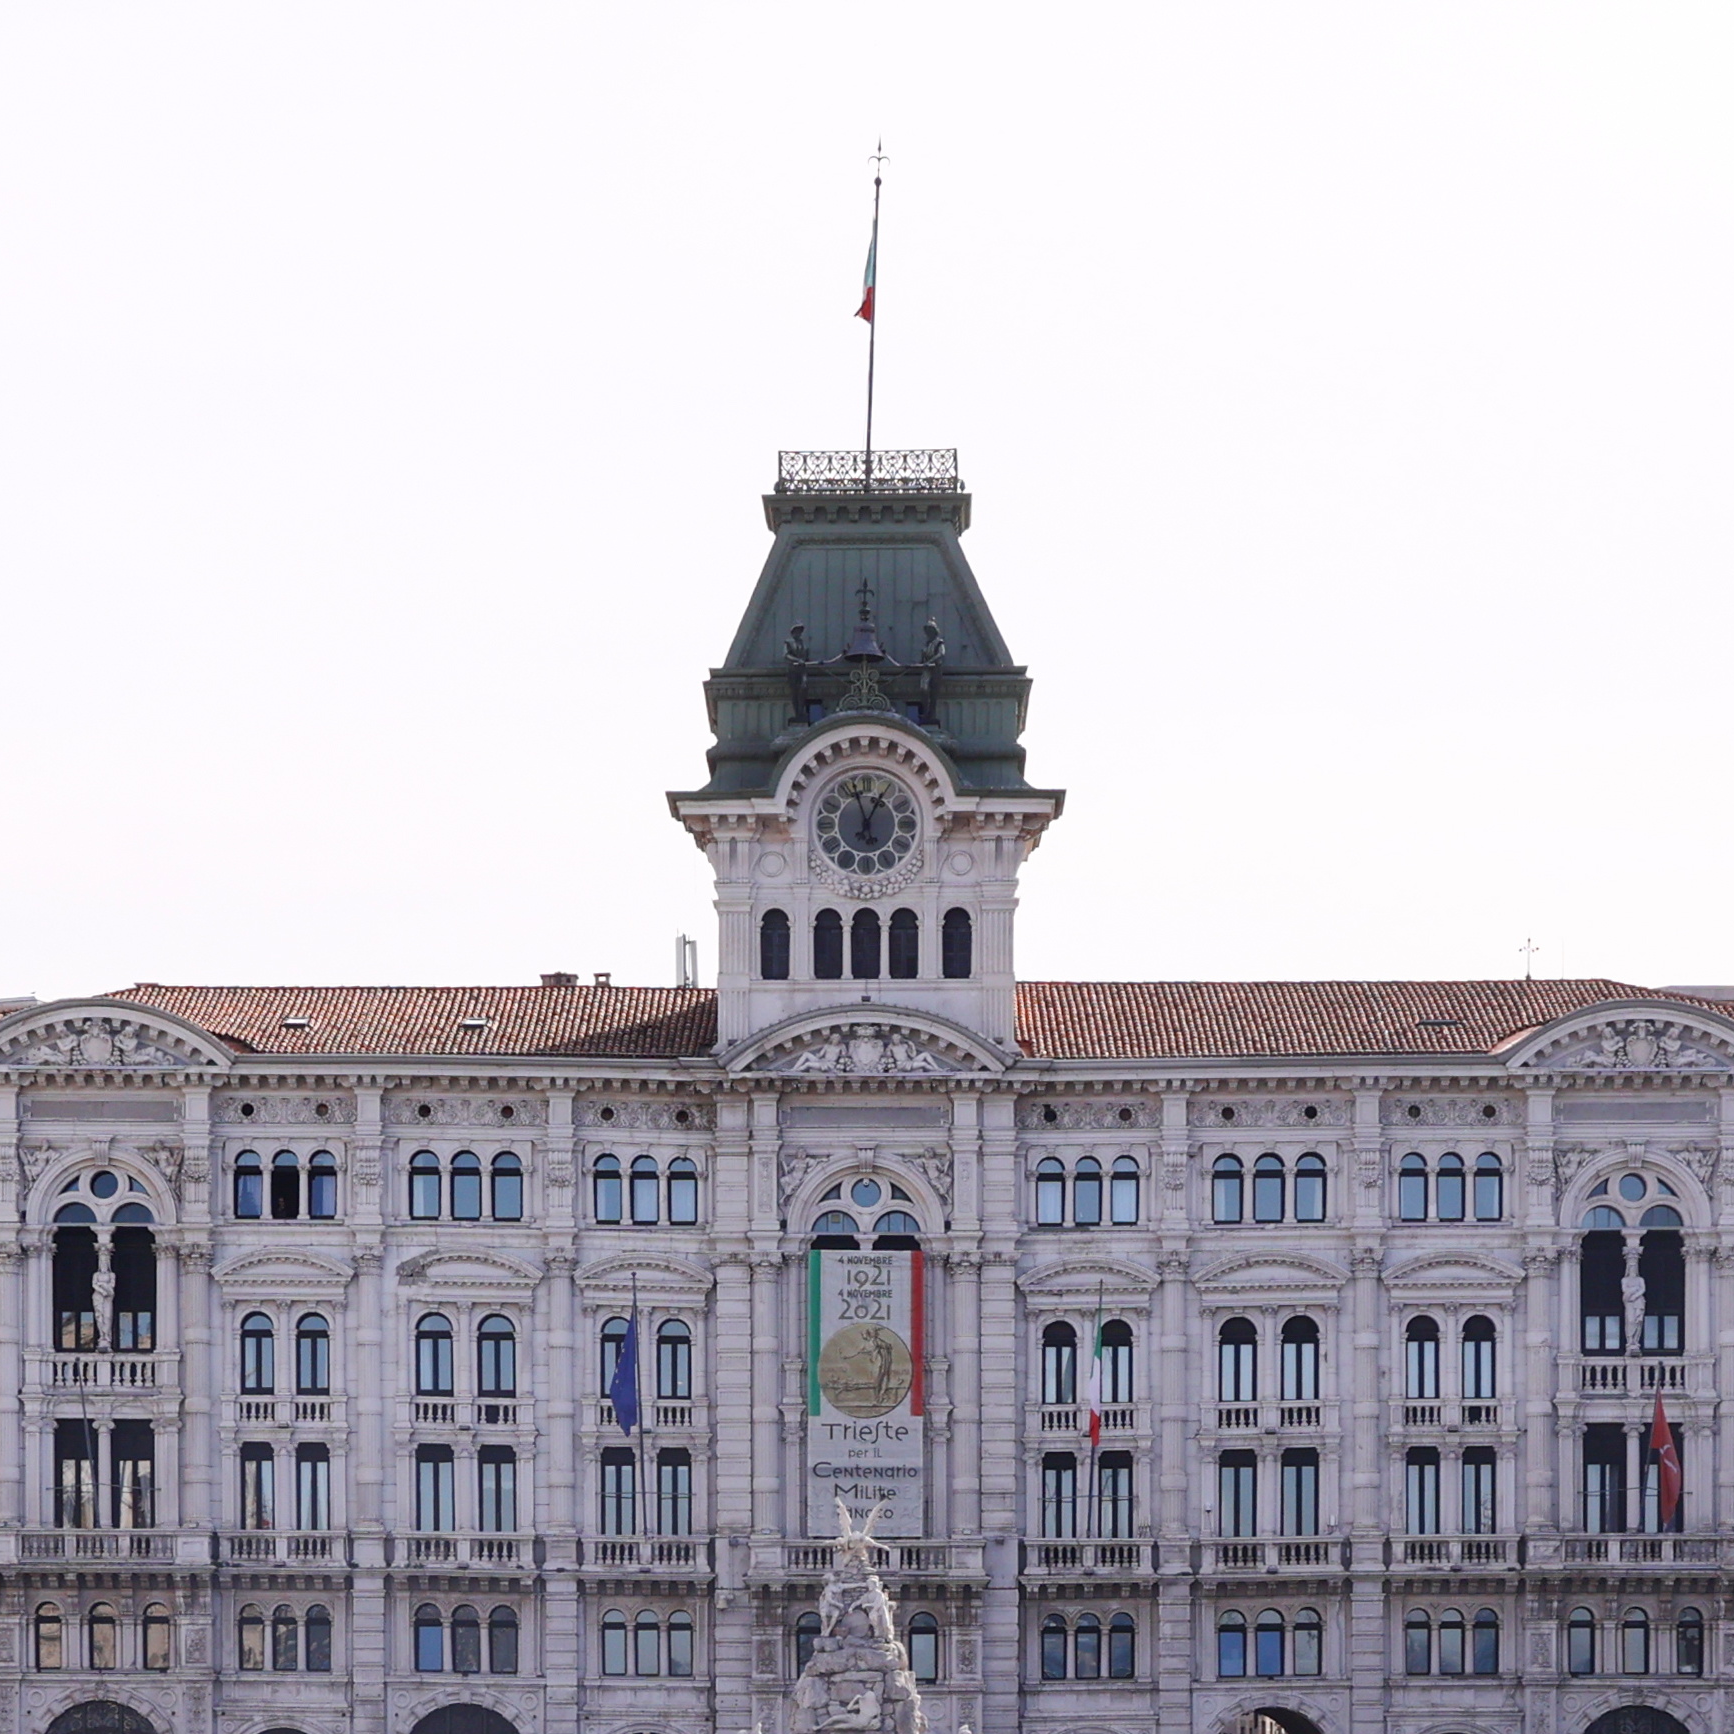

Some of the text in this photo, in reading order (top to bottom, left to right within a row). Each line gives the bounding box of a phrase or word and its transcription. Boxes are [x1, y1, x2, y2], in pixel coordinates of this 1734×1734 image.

[837, 1256, 893, 1265] 4 NOVEMBRE
[847, 1265, 890, 1288] 1921
[837, 1289, 893, 1298] 4 NOVEMBRE
[838, 1299, 890, 1320] 2021
[821, 1421, 908, 1444] Trieste
[848, 1449, 868, 1458] per
